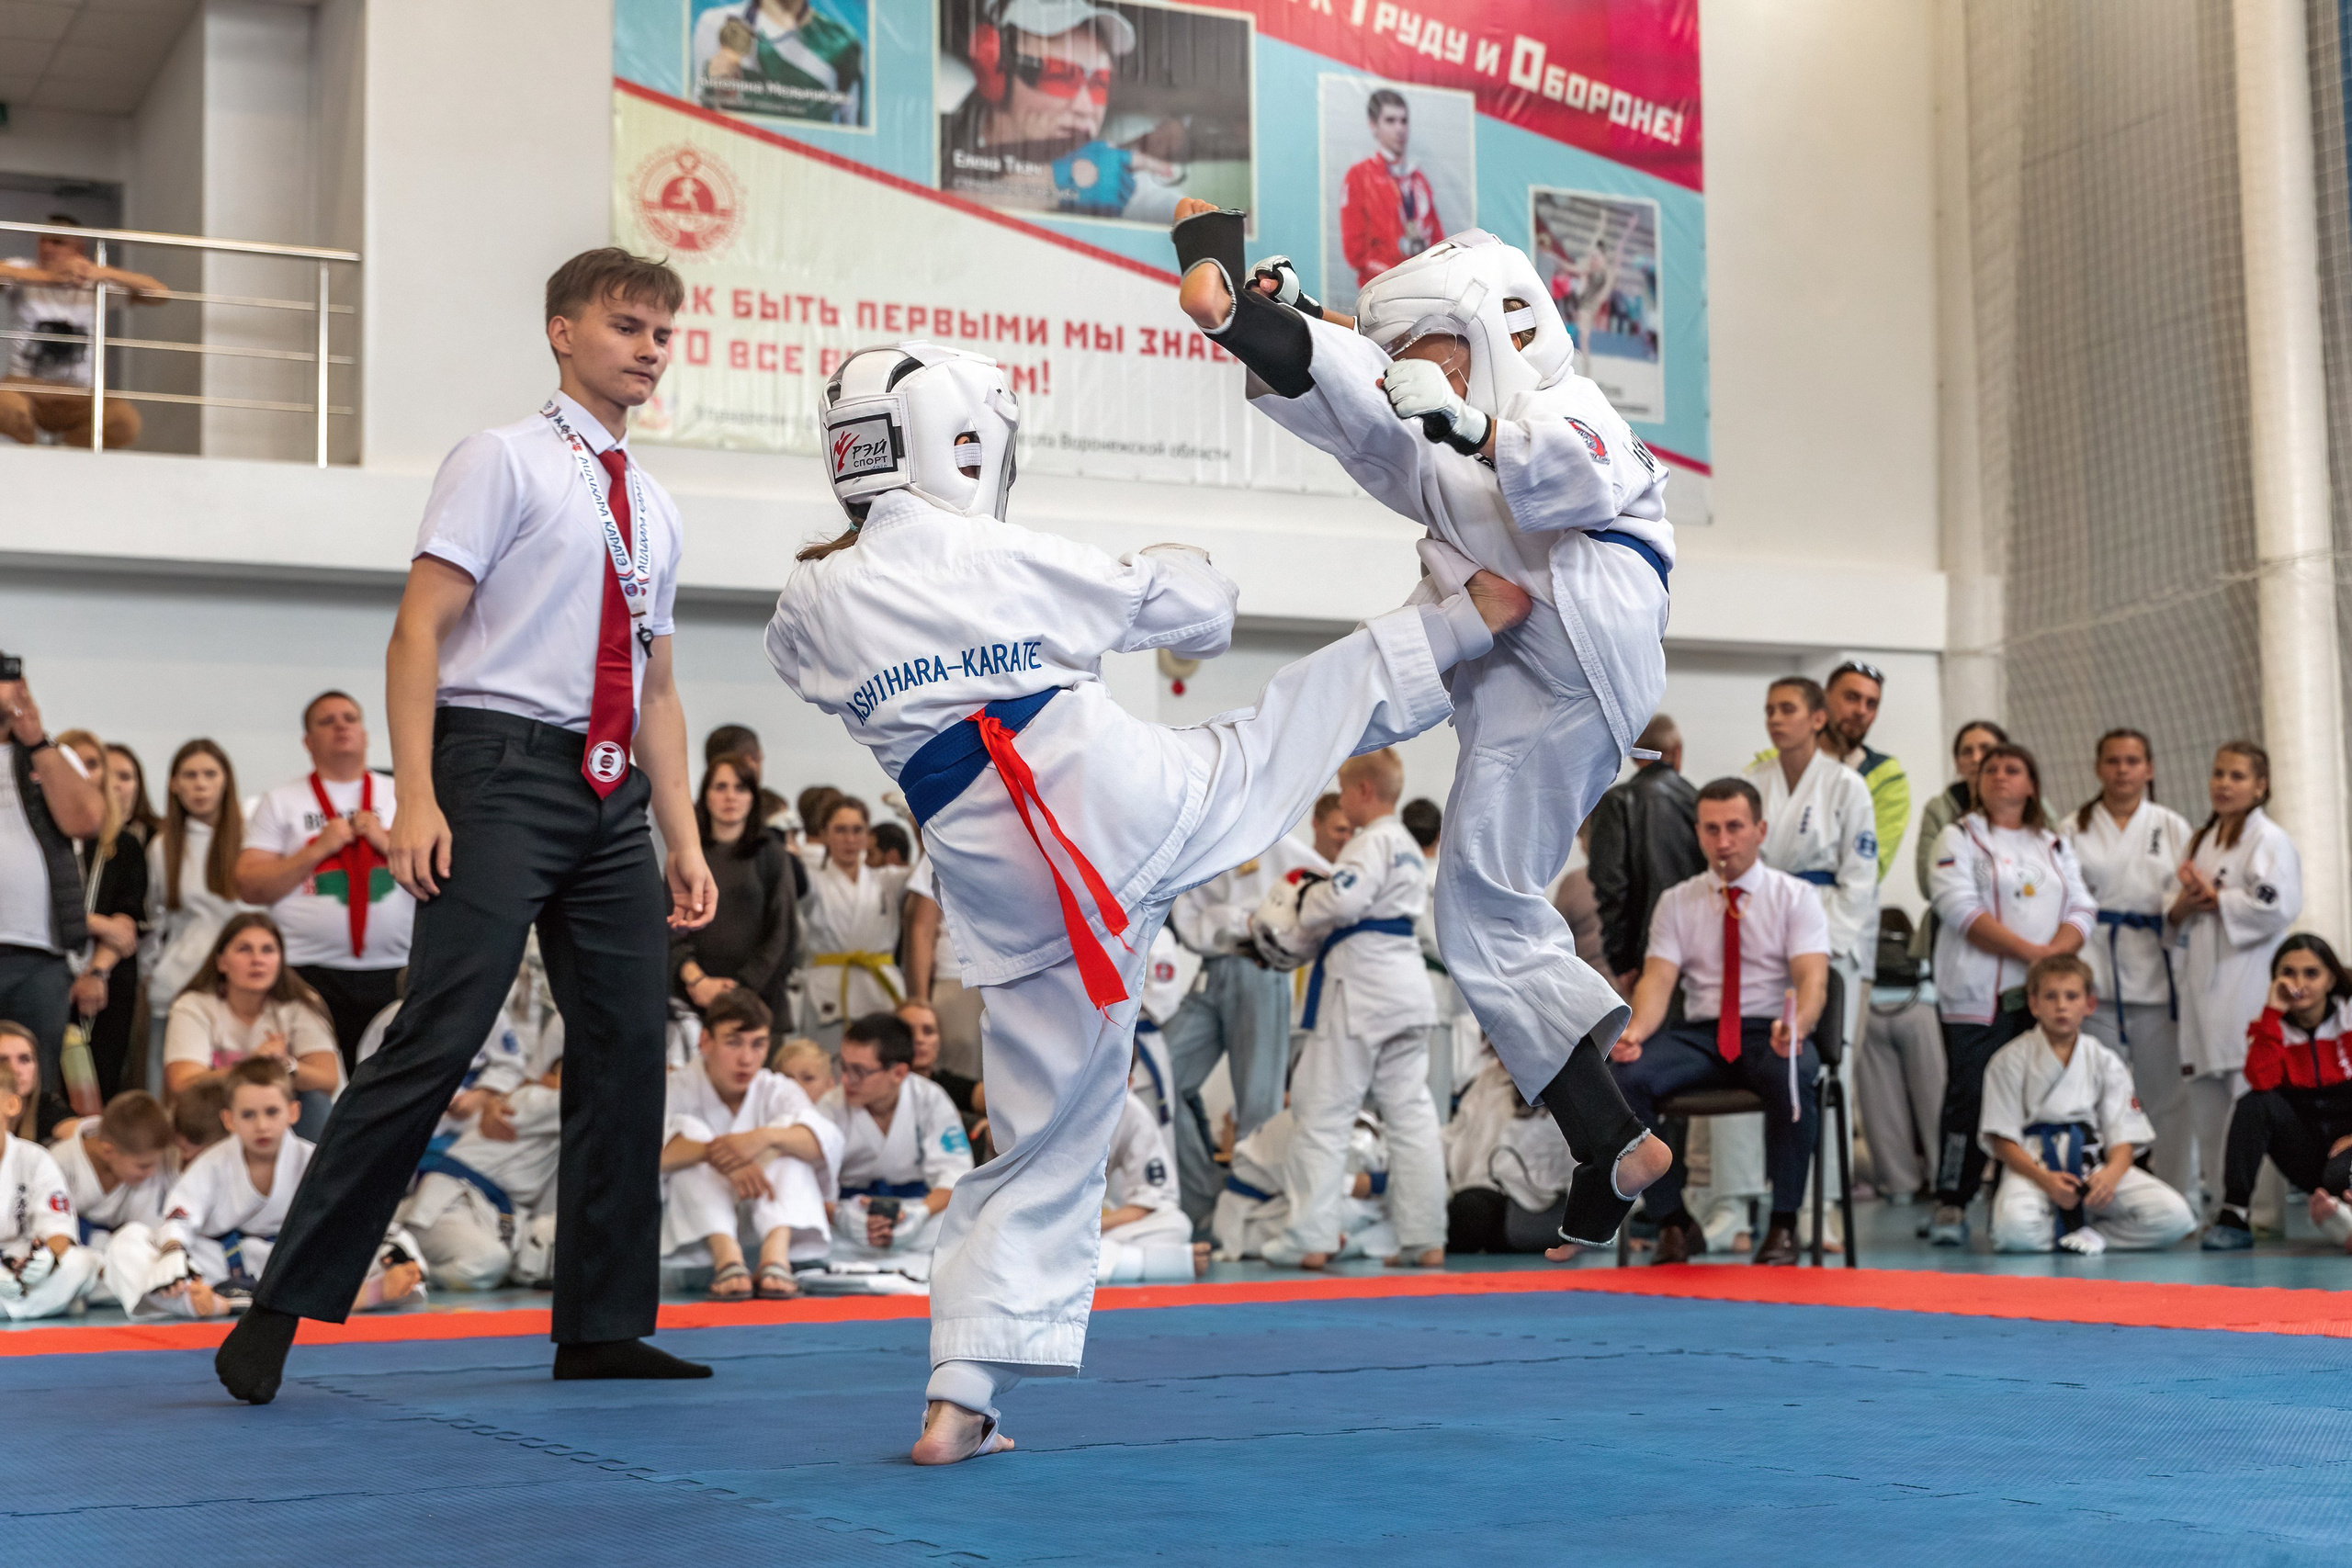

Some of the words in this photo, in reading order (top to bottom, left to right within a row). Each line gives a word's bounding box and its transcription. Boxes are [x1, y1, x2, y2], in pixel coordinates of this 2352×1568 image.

[731, 288, 839, 326] БЫТЬ
[856, 300, 1048, 346] ПЕРВЫМИ
[1064, 320, 1125, 354] МЫ
[1138, 326, 1240, 365] ЗНАЕ
[729, 340, 803, 375] ВСЕ
[853, 438, 888, 459] РЭЙ
[854, 456, 888, 468] СПОРТ
